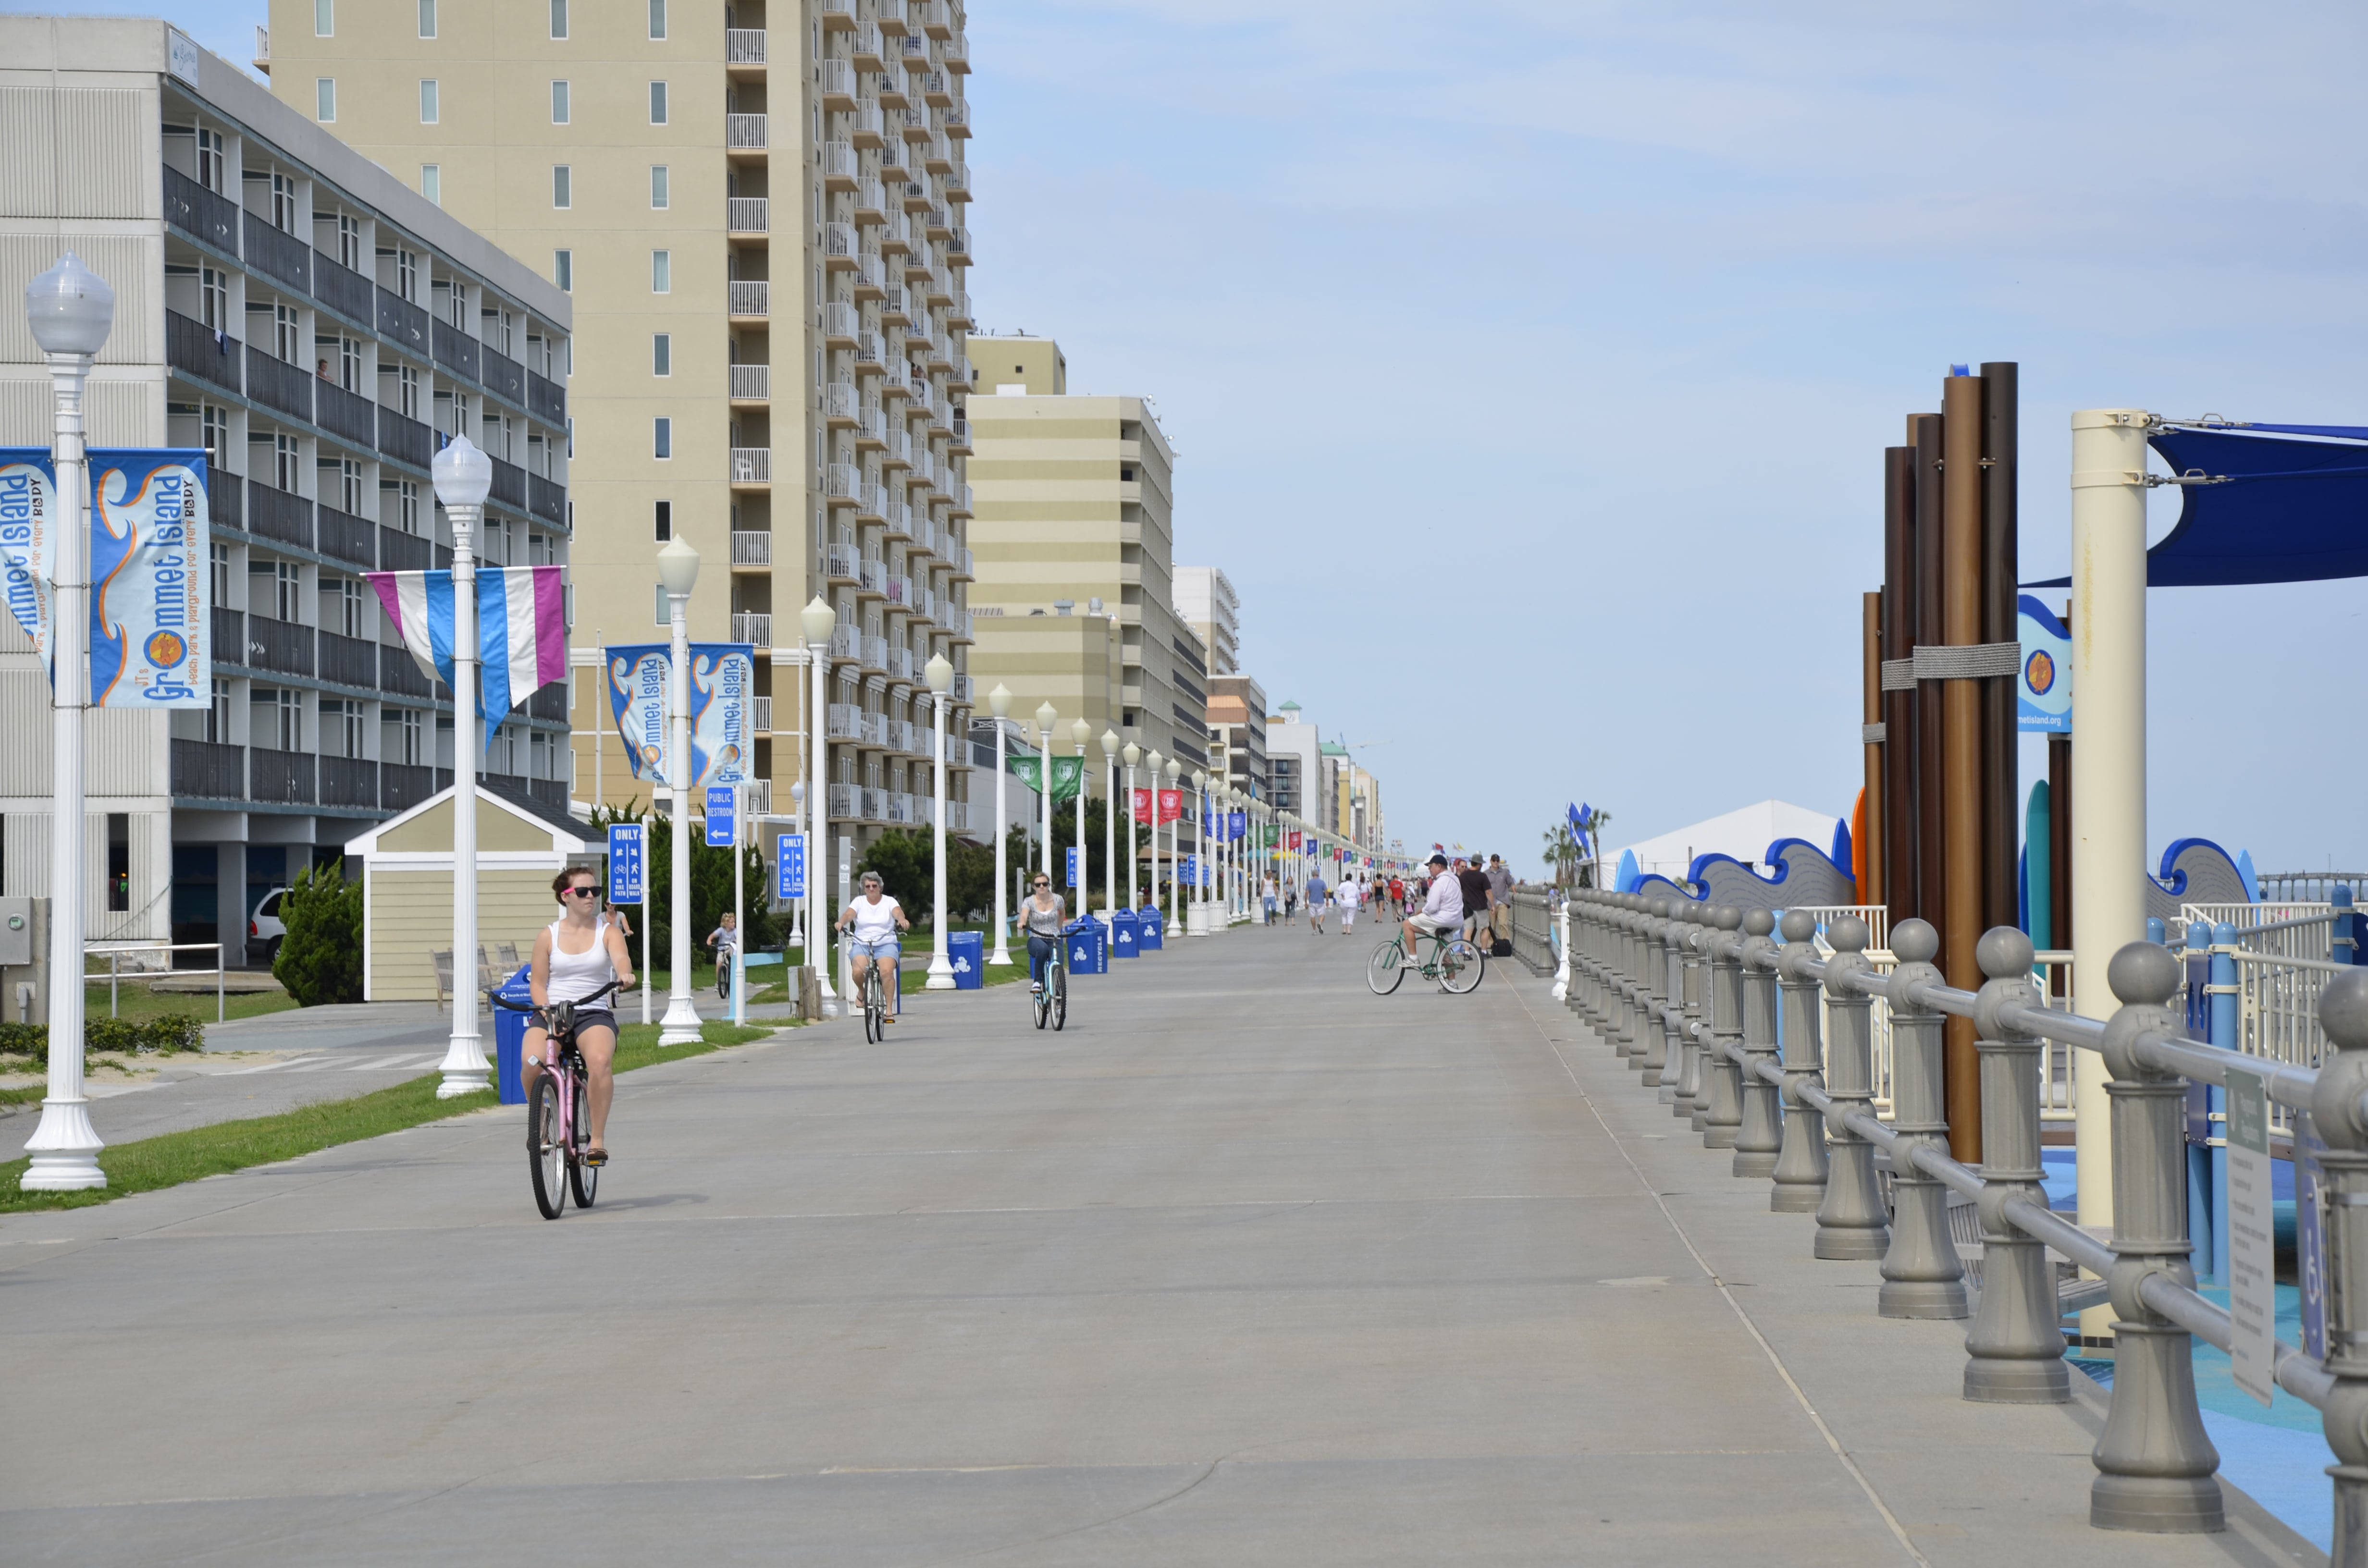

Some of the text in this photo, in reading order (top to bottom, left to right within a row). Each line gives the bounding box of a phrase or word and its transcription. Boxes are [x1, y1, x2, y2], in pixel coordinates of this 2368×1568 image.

[0, 472, 31, 547] Island
[144, 474, 184, 548] Island
[33, 520, 44, 547] every
[185, 520, 196, 547] every
[187, 570, 199, 623] playground
[188, 634, 199, 655] park
[188, 659, 198, 685] beach
[638, 657, 660, 699] Island
[718, 658, 740, 699] Island
[709, 793, 731, 803] PUBLIC
[708, 807, 733, 817] RESTROOM
[616, 829, 639, 840] ONLY
[783, 838, 802, 847] ONLY
